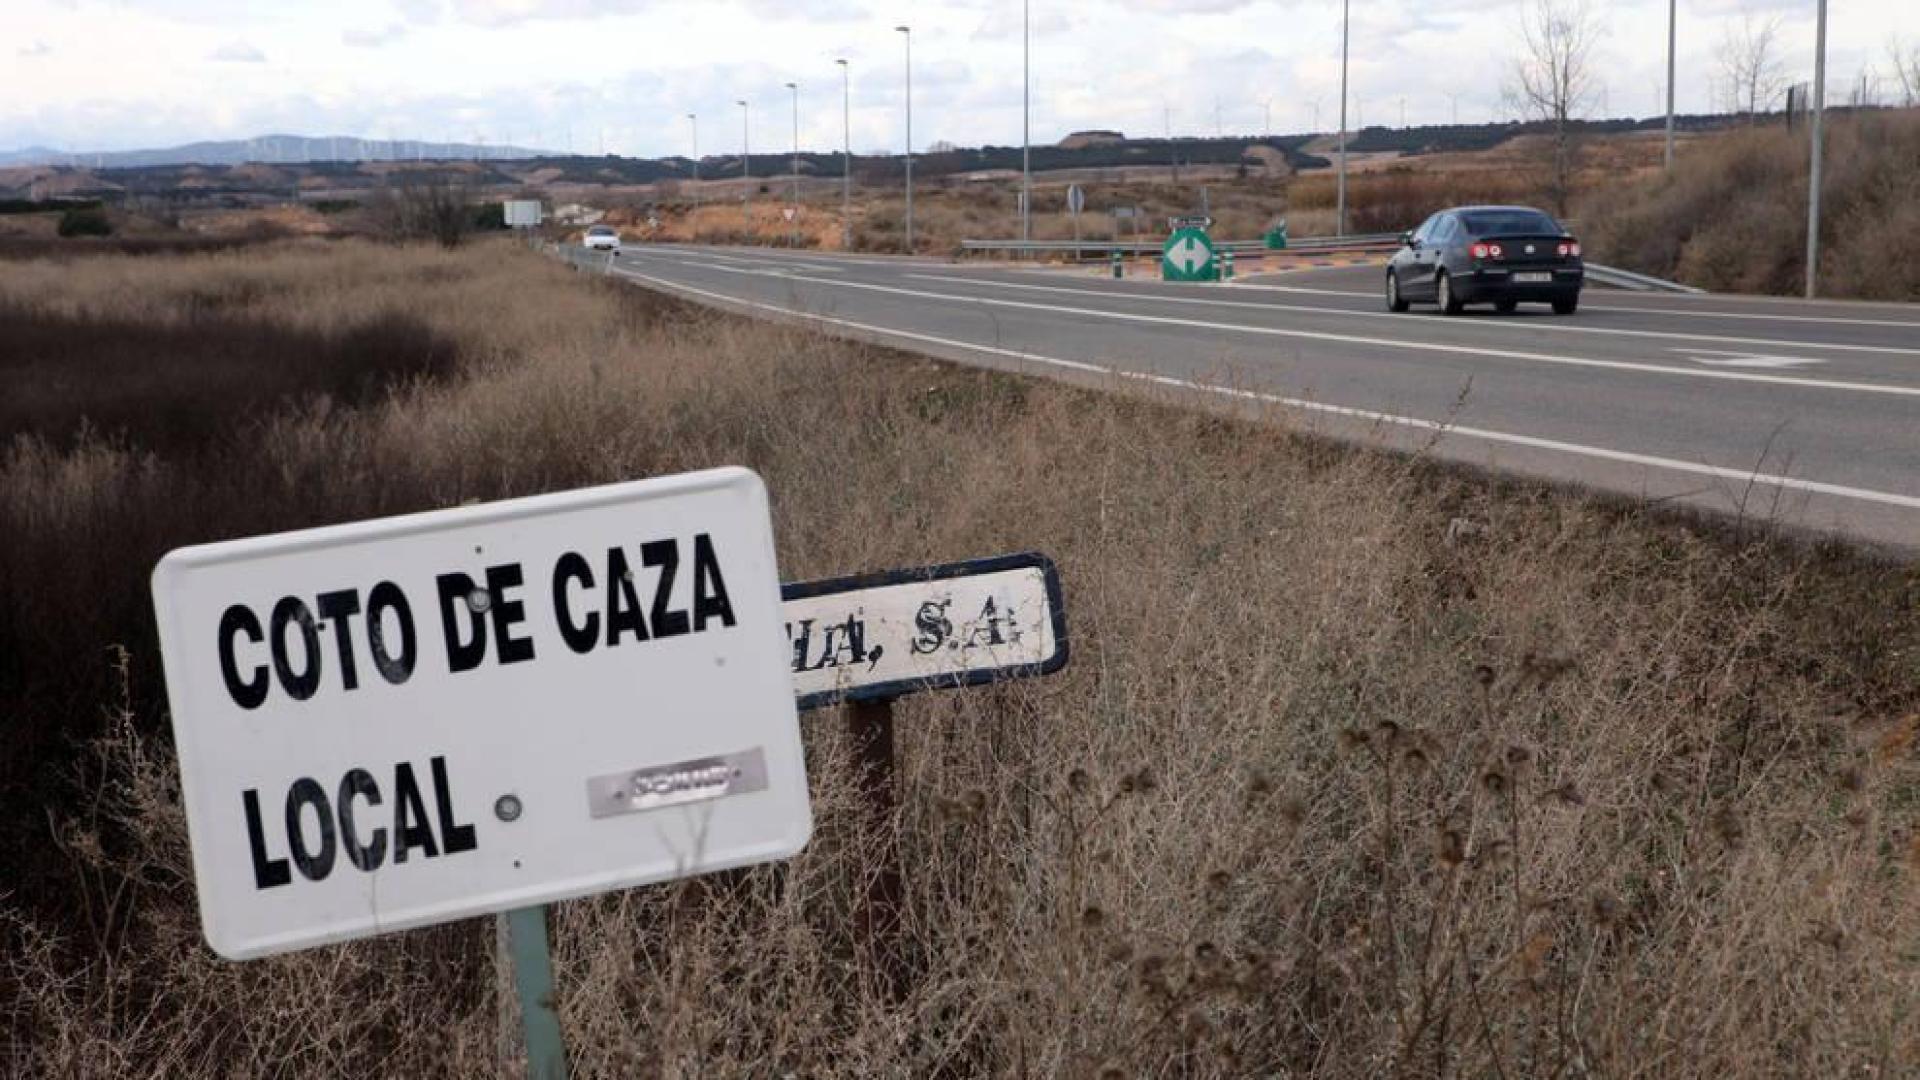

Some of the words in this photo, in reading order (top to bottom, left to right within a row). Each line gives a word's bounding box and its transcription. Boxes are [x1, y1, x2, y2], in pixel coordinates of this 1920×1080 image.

[218, 580, 418, 711] COTO
[436, 562, 536, 673] DE
[551, 532, 738, 654] CAZA
[241, 755, 479, 891] LOCAL
